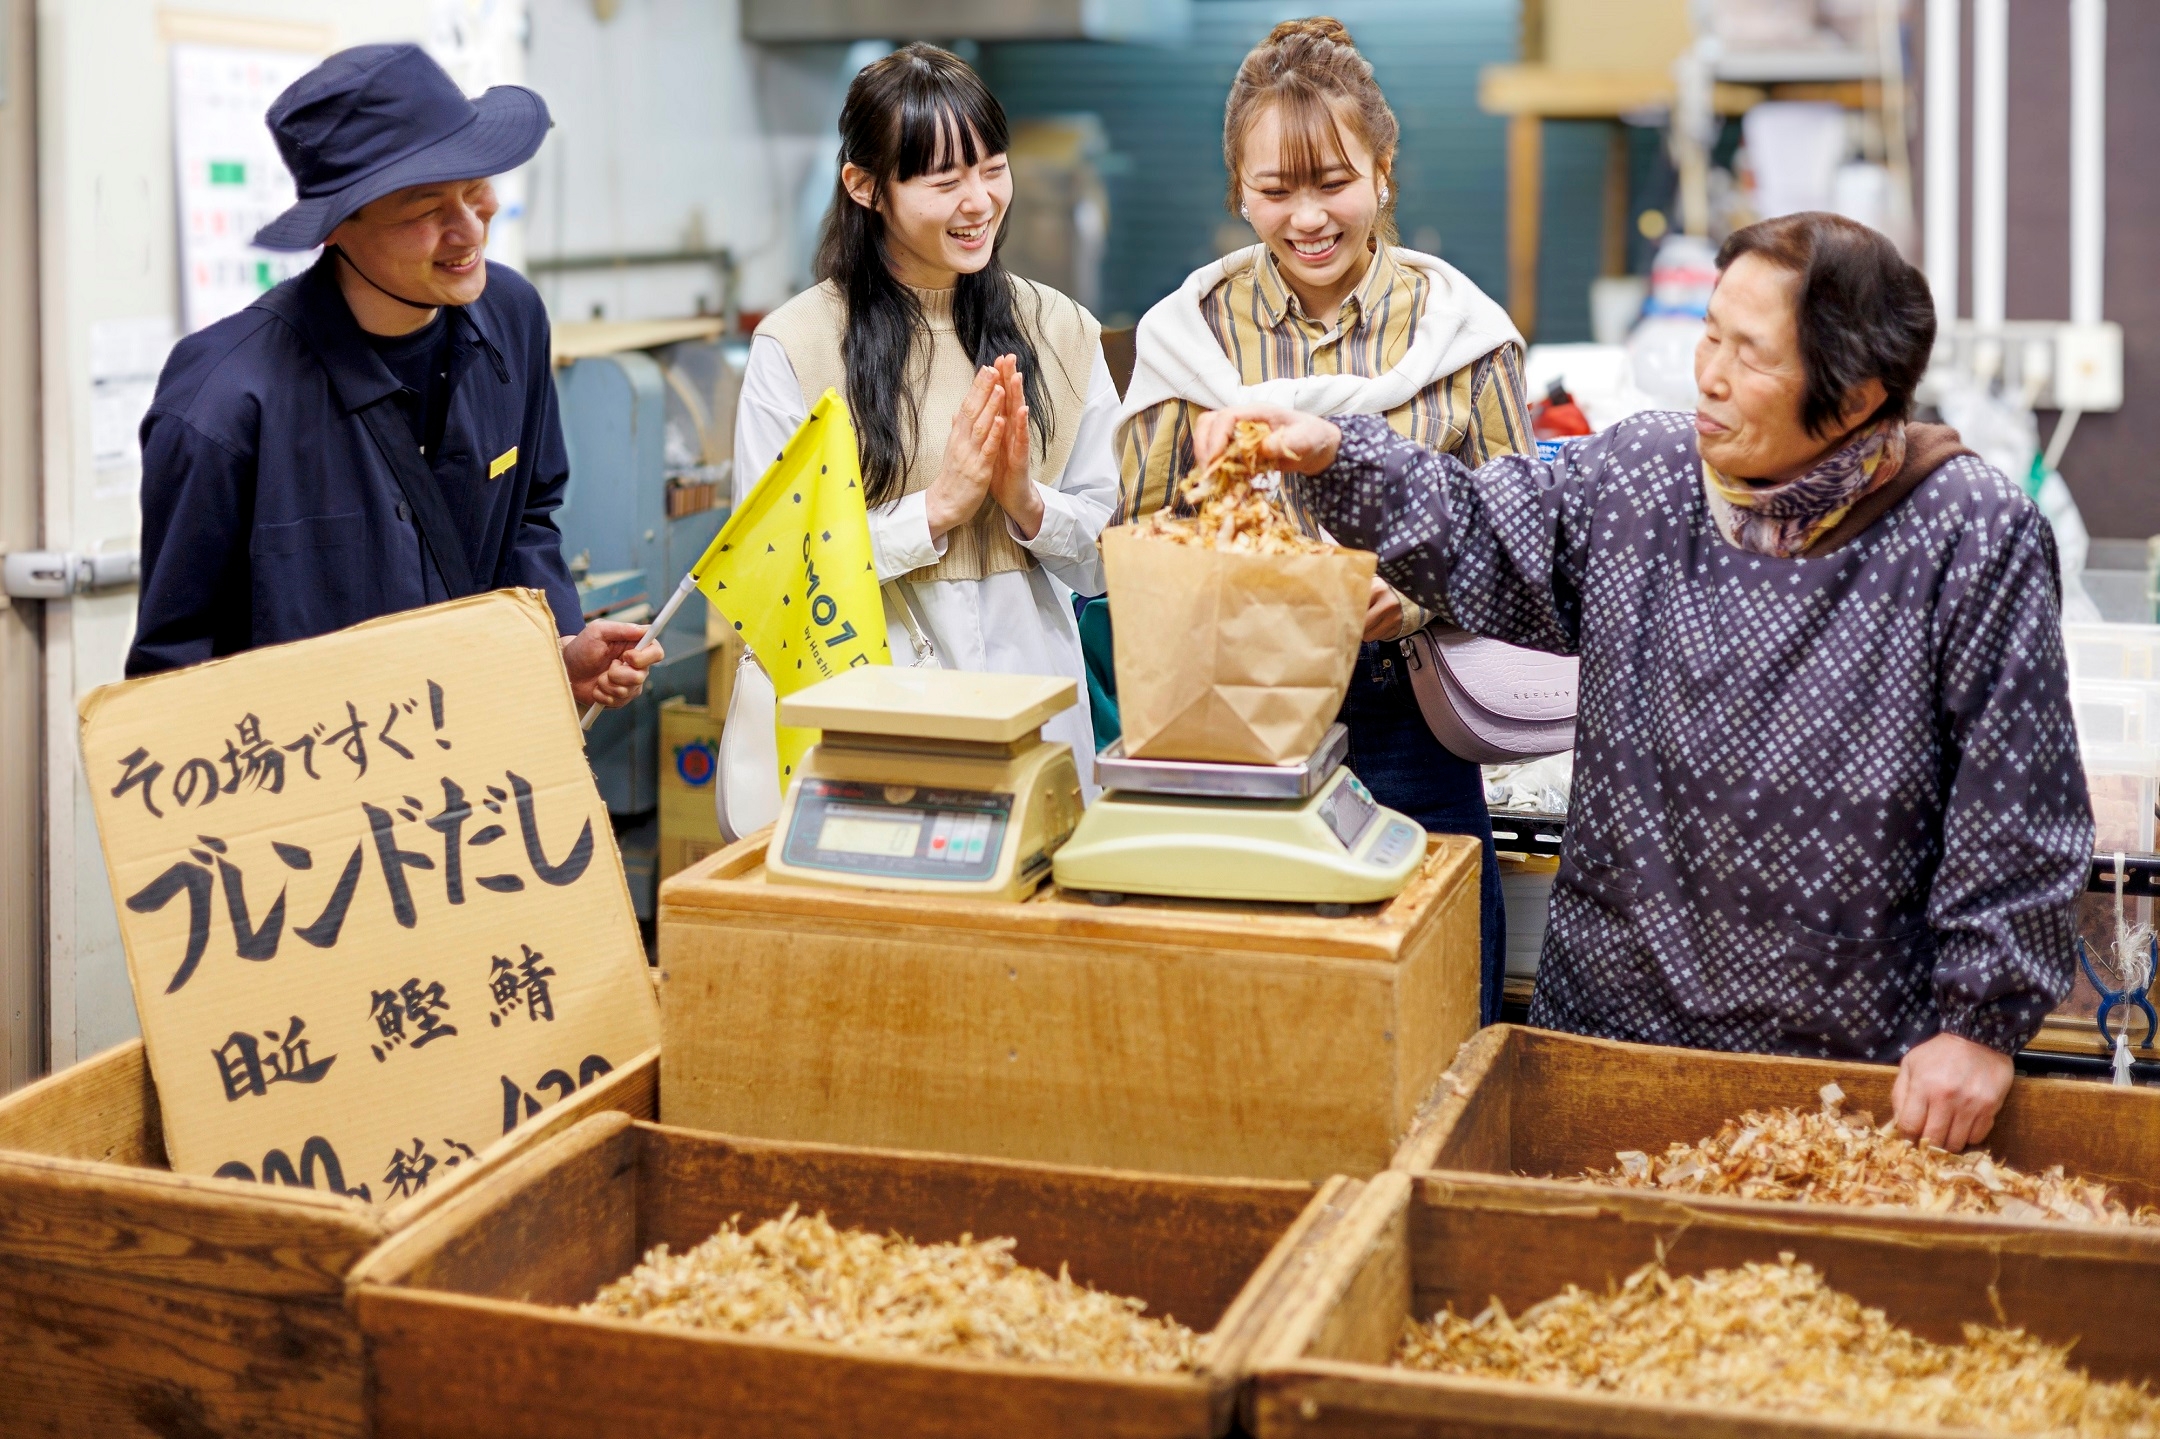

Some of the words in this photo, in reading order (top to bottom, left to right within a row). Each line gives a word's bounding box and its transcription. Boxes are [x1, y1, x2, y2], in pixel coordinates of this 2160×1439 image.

[804, 625, 811, 641] by
[126, 770, 595, 995] ブレンドだし
[211, 1015, 337, 1102] 目近
[367, 977, 458, 1063] 鰹
[488, 944, 556, 1027] 鯖
